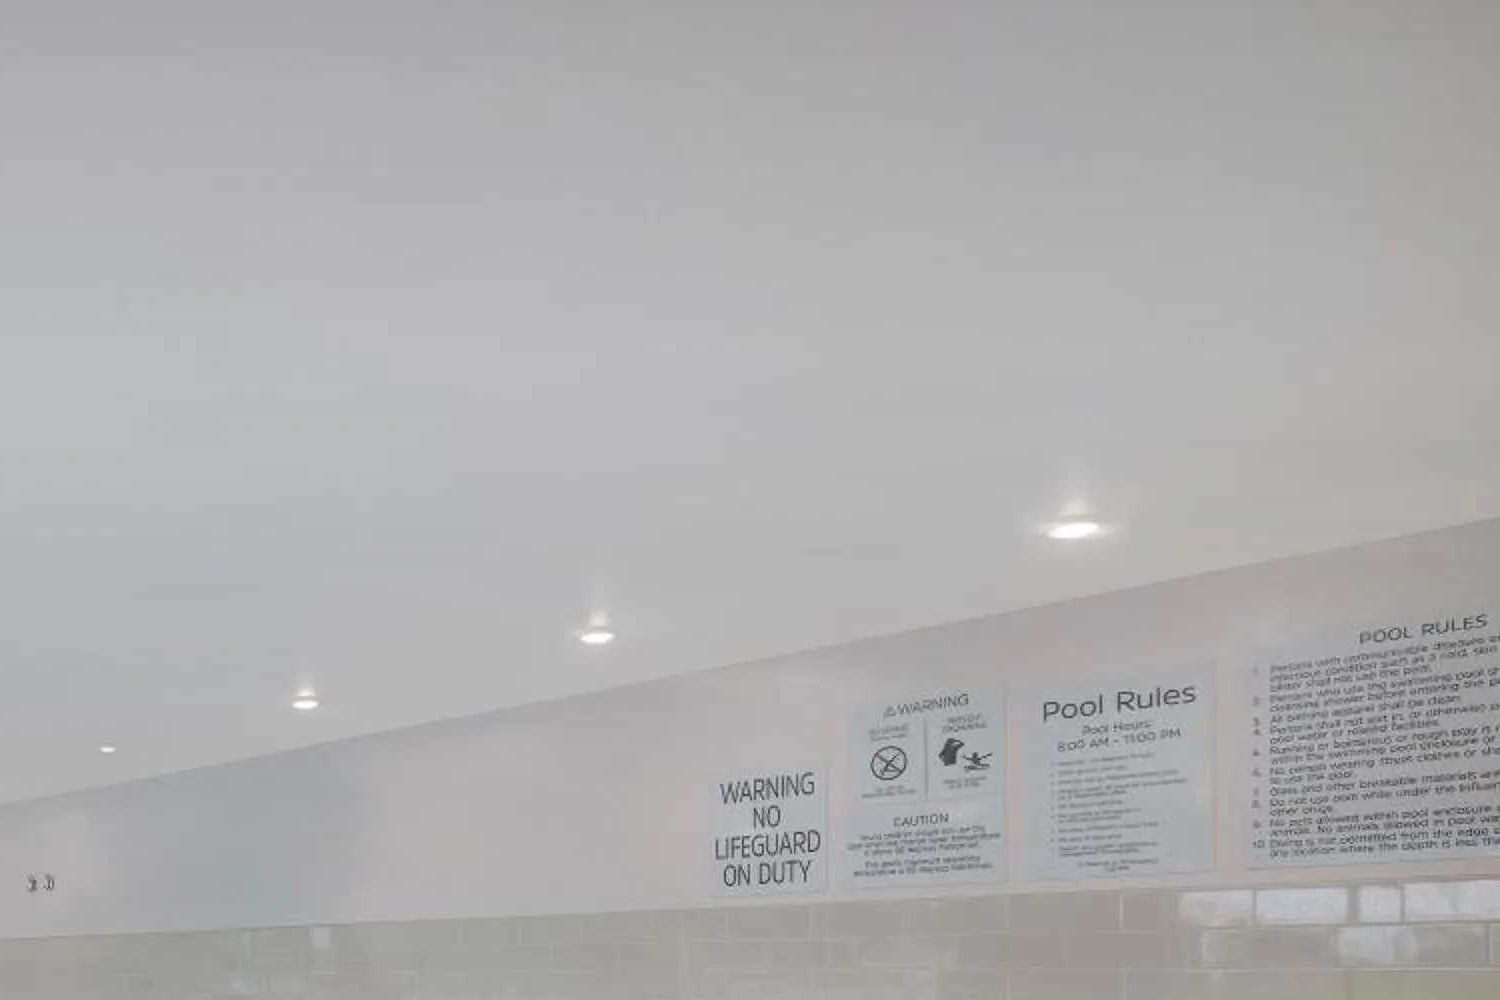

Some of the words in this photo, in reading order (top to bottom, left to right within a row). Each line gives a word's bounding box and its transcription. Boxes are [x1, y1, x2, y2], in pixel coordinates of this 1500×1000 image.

[1359, 626, 1413, 645] POOL
[1421, 613, 1488, 637] RULES
[897, 693, 969, 715] WARNING
[1043, 693, 1103, 722] Pool
[1117, 687, 1197, 713] Rules
[1082, 724, 1109, 735] Pool
[1089, 737, 1109, 748] AM
[1160, 728, 1181, 739] PM
[719, 771, 815, 804] WARNING
[753, 805, 781, 829] NO
[893, 813, 949, 827] CAUTION
[715, 830, 821, 860] LIFEGUARD
[723, 864, 751, 887] ON
[759, 859, 813, 885] DUTY
